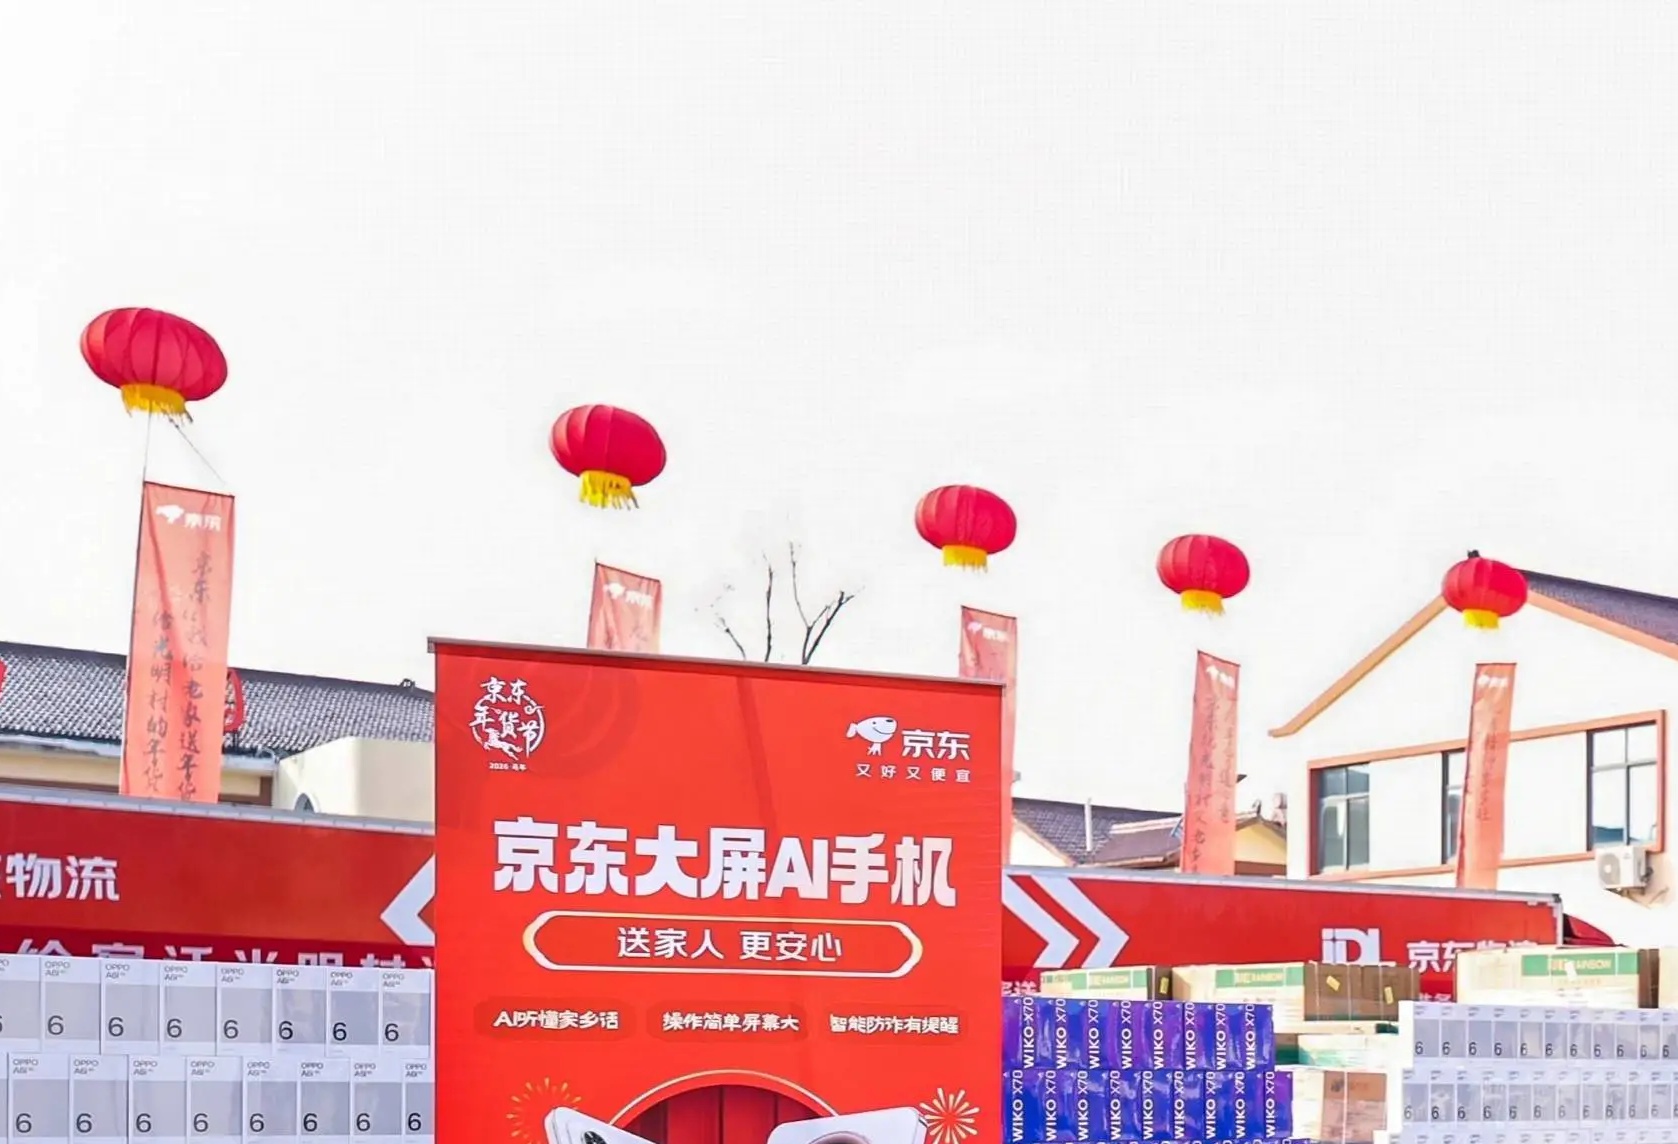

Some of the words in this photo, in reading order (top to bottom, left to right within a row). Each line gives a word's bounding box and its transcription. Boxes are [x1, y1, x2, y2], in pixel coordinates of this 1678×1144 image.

[901, 729, 971, 760] 京东
[493, 816, 957, 907] 京东大屏AI手机
[617, 926, 724, 960] 送家人
[740, 930, 843, 962] 更安心
[45, 961, 70, 969] OPPO
[105, 963, 130, 972] OPPO
[164, 965, 188, 973] OPPO
[221, 967, 245, 976] OPPO
[276, 969, 299, 977] OPPO
[330, 971, 352, 979] OPPO
[382, 972, 405, 980] OPPO
[493, 1009, 619, 1030] AI听懂家乡话
[663, 1012, 799, 1033] 操作简单屏幕大
[1023, 998, 1034, 1023] X70
[1056, 999, 1066, 1026] X70
[1088, 1000, 1099, 1025] X70
[1121, 1001, 1132, 1025] X70
[1153, 1001, 1163, 1026] X70
[1186, 1002, 1195, 1027] X70
[1216, 1004, 1226, 1027] X70
[1245, 1004, 1255, 1028] X70
[48, 1015, 63, 1035] 6
[108, 1017, 123, 1036] 6
[167, 1019, 182, 1038] 6
[224, 1020, 238, 1039] 6
[279, 1021, 293, 1040] 6
[333, 1022, 347, 1041] 6
[385, 1023, 399, 1042] 6
[829, 1013, 959, 1035] 智能防诈有提醒
[1023, 1025, 1034, 1068] WIKO
[1056, 1026, 1066, 1069] WIKO
[1088, 1027, 1099, 1069] WIKO
[1121, 1027, 1132, 1069] WIKO
[1153, 1028, 1163, 1069] WIKO
[1186, 1028, 1195, 1070] WIKO
[1216, 1029, 1226, 1070] WIKO
[1245, 1030, 1255, 1070] WIKO
[1012, 1070, 1024, 1094] X70
[1046, 1071, 1056, 1095] X70
[1078, 1071, 1088, 1095] X70
[1111, 1071, 1121, 1094] X70
[1143, 1071, 1153, 1095] X70
[1175, 1071, 1184, 1094] X70
[1206, 1072, 1216, 1095] X70
[1236, 1072, 1245, 1095] X70
[1266, 1072, 1275, 1095] X70
[1012, 1099, 1024, 1141] WIKO
[1046, 1099, 1056, 1140] WIKO
[1078, 1100, 1088, 1140] WIKO
[1111, 1099, 1121, 1140] WIKO
[1143, 1099, 1153, 1139] WIKO
[1175, 1099, 1184, 1139] WIKO
[1206, 1099, 1216, 1138] WIKO
[1236, 1100, 1245, 1138] WIKO
[1266, 1099, 1275, 1138] WIKO
